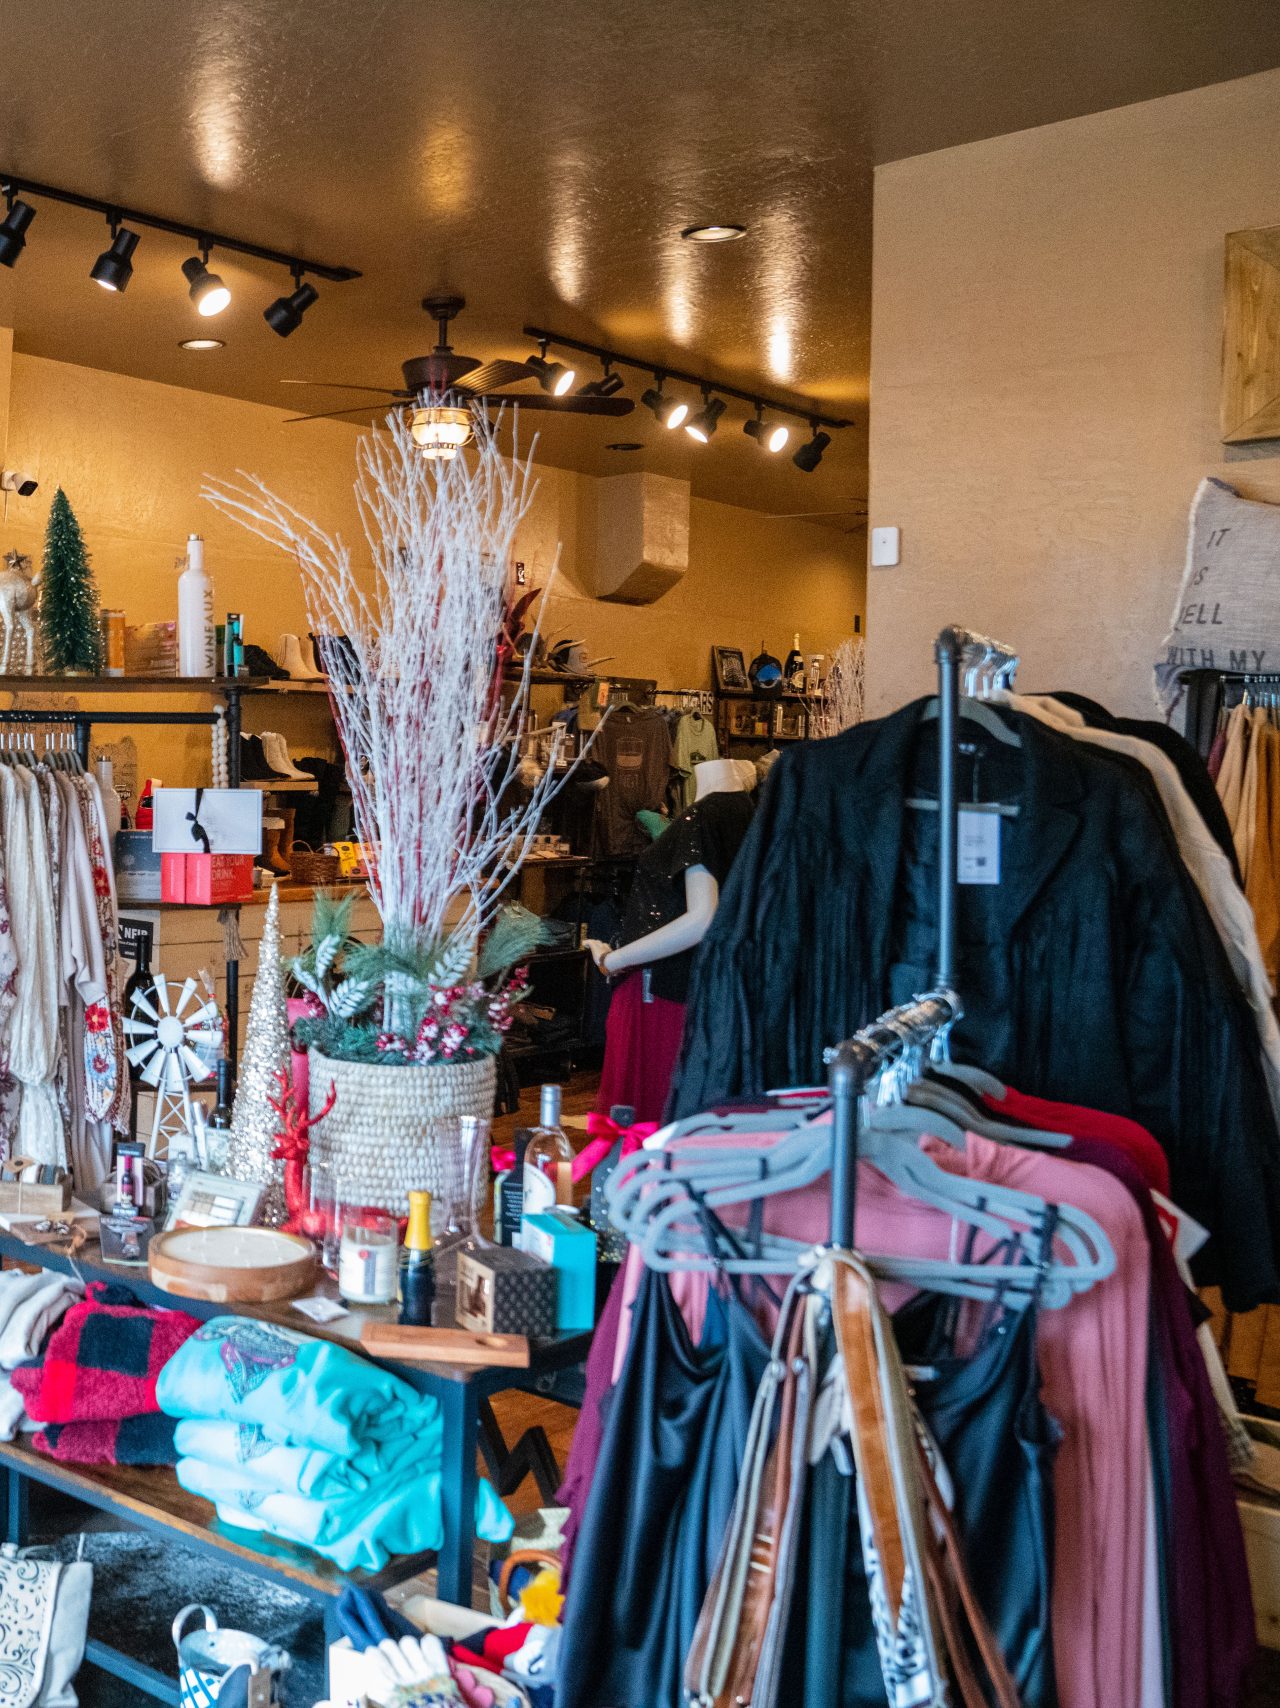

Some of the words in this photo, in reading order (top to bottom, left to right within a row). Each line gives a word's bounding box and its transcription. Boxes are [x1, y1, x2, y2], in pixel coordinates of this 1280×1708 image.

[1207, 528, 1231, 549] IT
[203, 589, 214, 669] WINEAUX
[1229, 650, 1266, 672] MY
